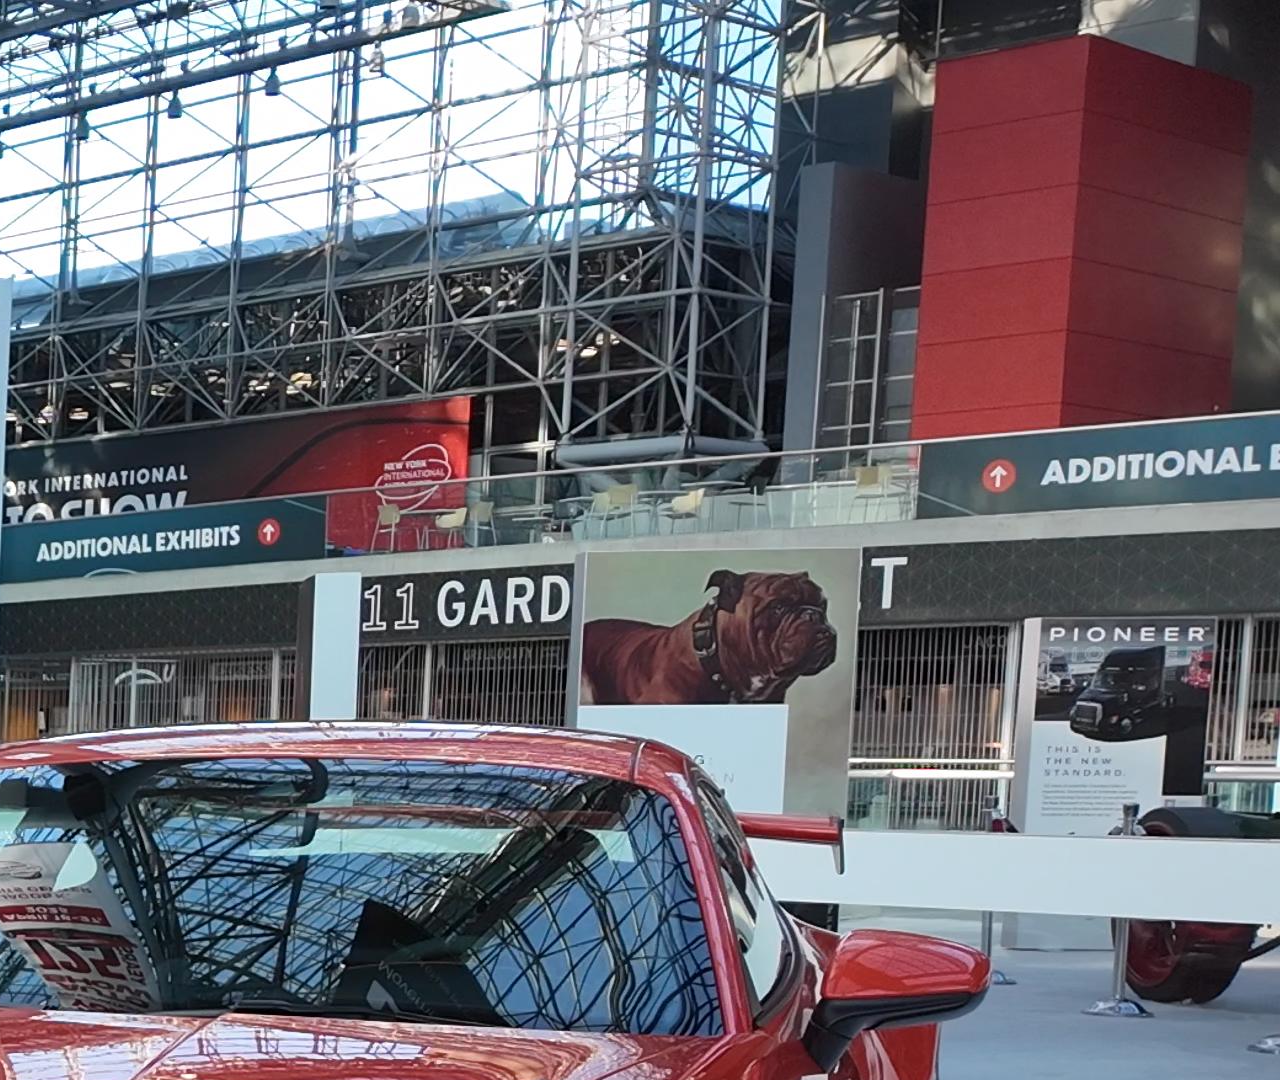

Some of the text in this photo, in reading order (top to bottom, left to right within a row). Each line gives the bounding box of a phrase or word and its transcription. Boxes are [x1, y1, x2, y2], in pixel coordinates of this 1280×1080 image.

[4, 464, 188, 497] ORK INTERNATIONAL
[1040, 445, 1262, 486] ADDITIONAL
[36, 524, 241, 562] ADDITIONAL EXHIBITS
[362, 574, 571, 631] 11 GARD
[1049, 627, 1206, 642] PIONEER
[1046, 757, 1072, 765] THE
[1047, 746, 1079, 754] THIS
